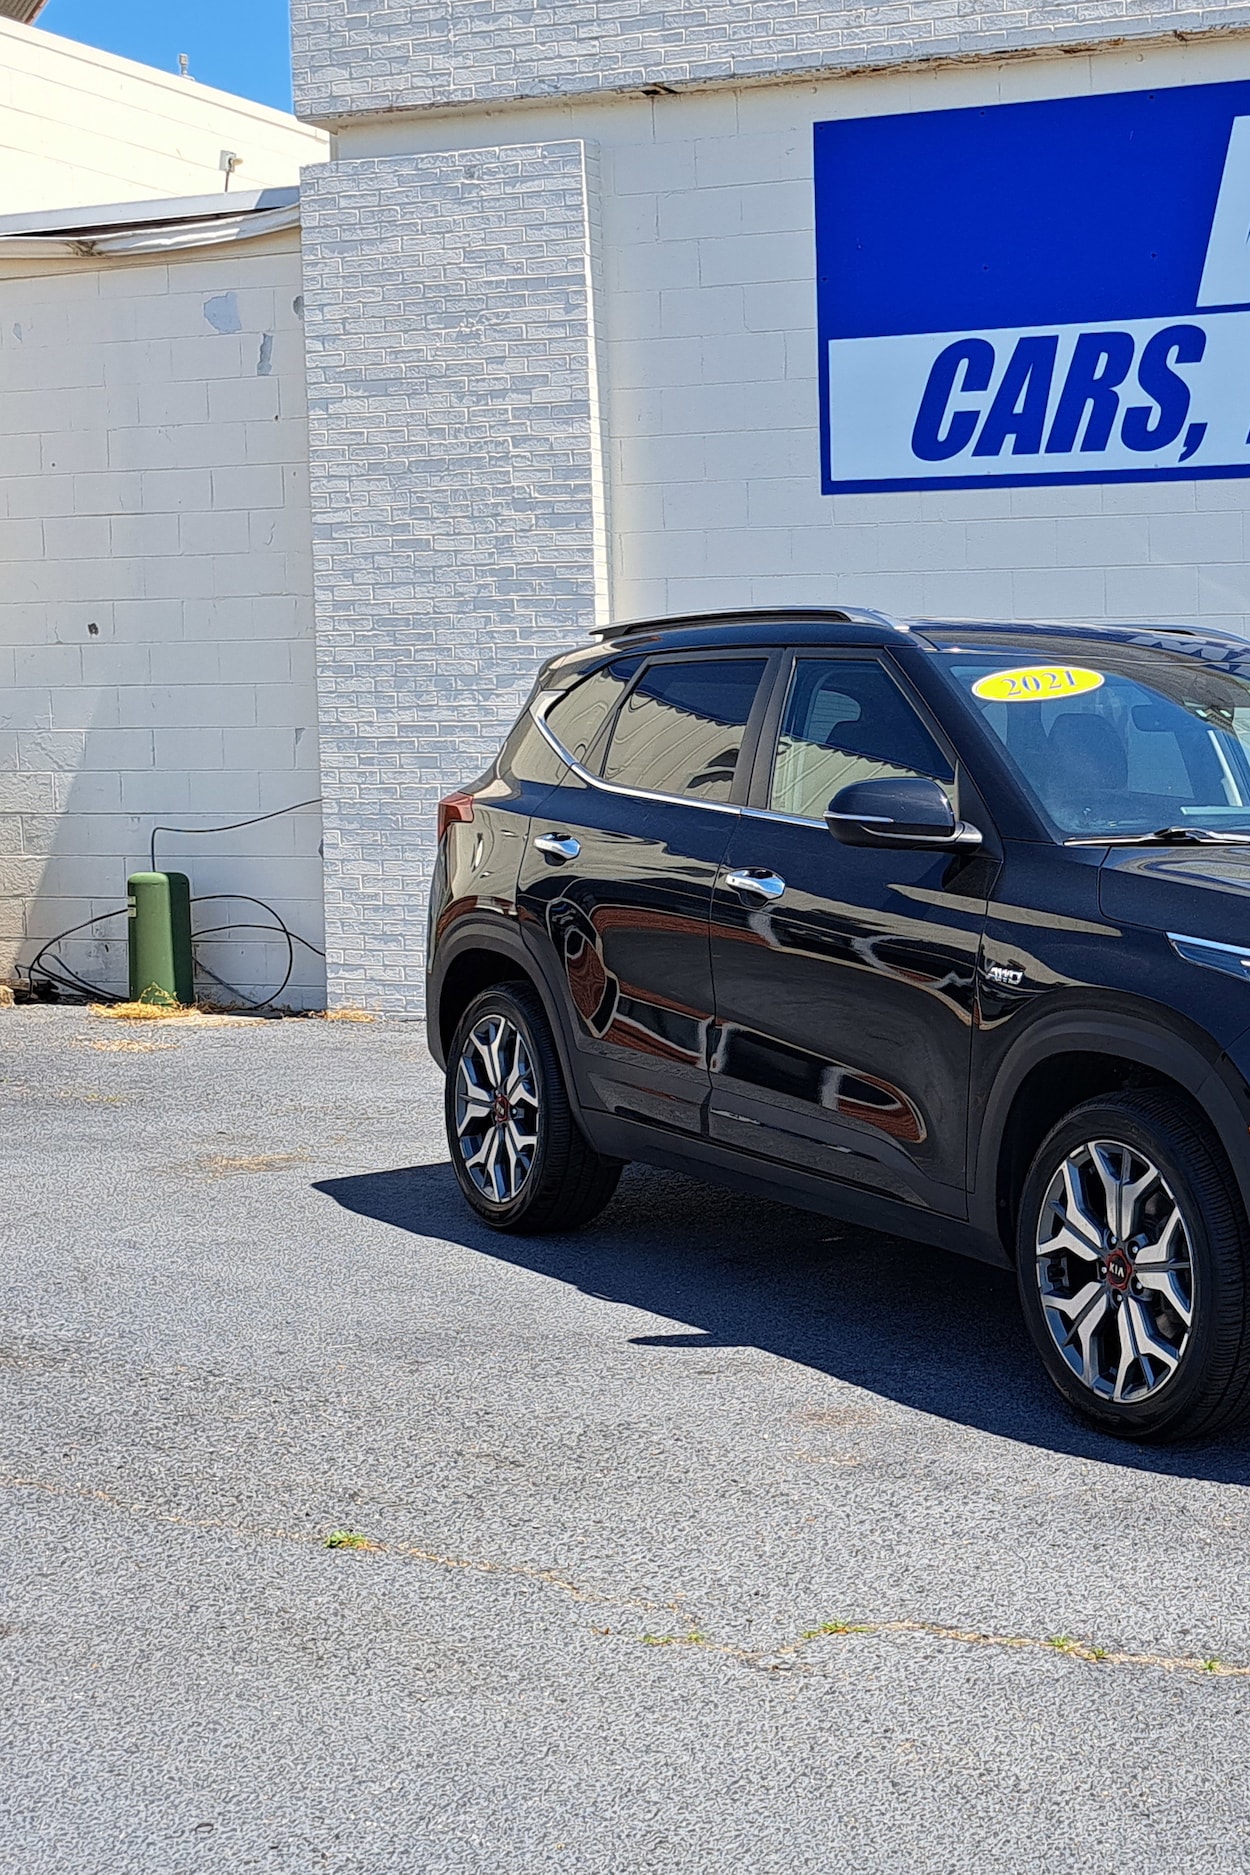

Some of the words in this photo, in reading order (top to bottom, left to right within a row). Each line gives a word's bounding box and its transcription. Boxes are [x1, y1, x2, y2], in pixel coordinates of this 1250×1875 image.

[910, 325, 1207, 464] CARS,
[1001, 670, 1076, 696] 2021
[1109, 1262, 1125, 1279] KIA
